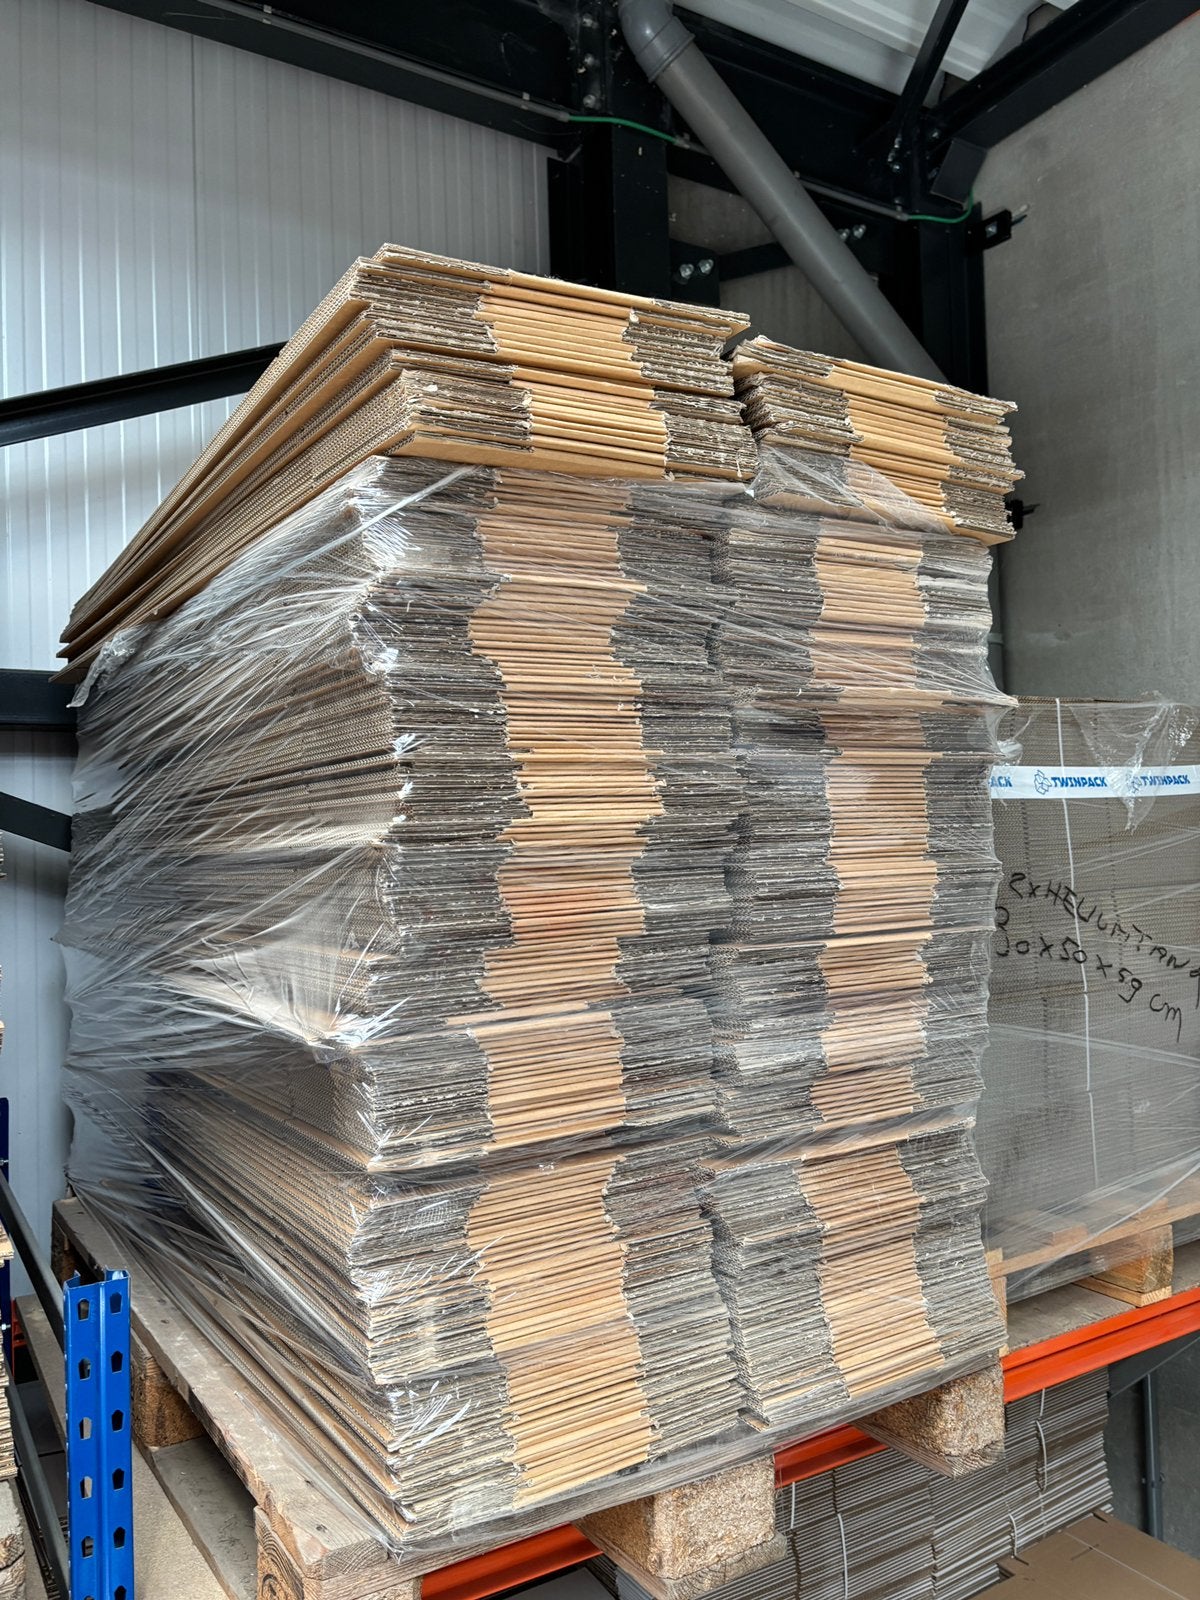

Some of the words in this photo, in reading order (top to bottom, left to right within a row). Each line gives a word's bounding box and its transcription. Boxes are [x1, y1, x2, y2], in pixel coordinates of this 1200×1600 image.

[989, 776, 1013, 788] ACK
[1051, 776, 1108, 789] TWINPACK
[1139, 774, 1191, 787] TWINPACK
